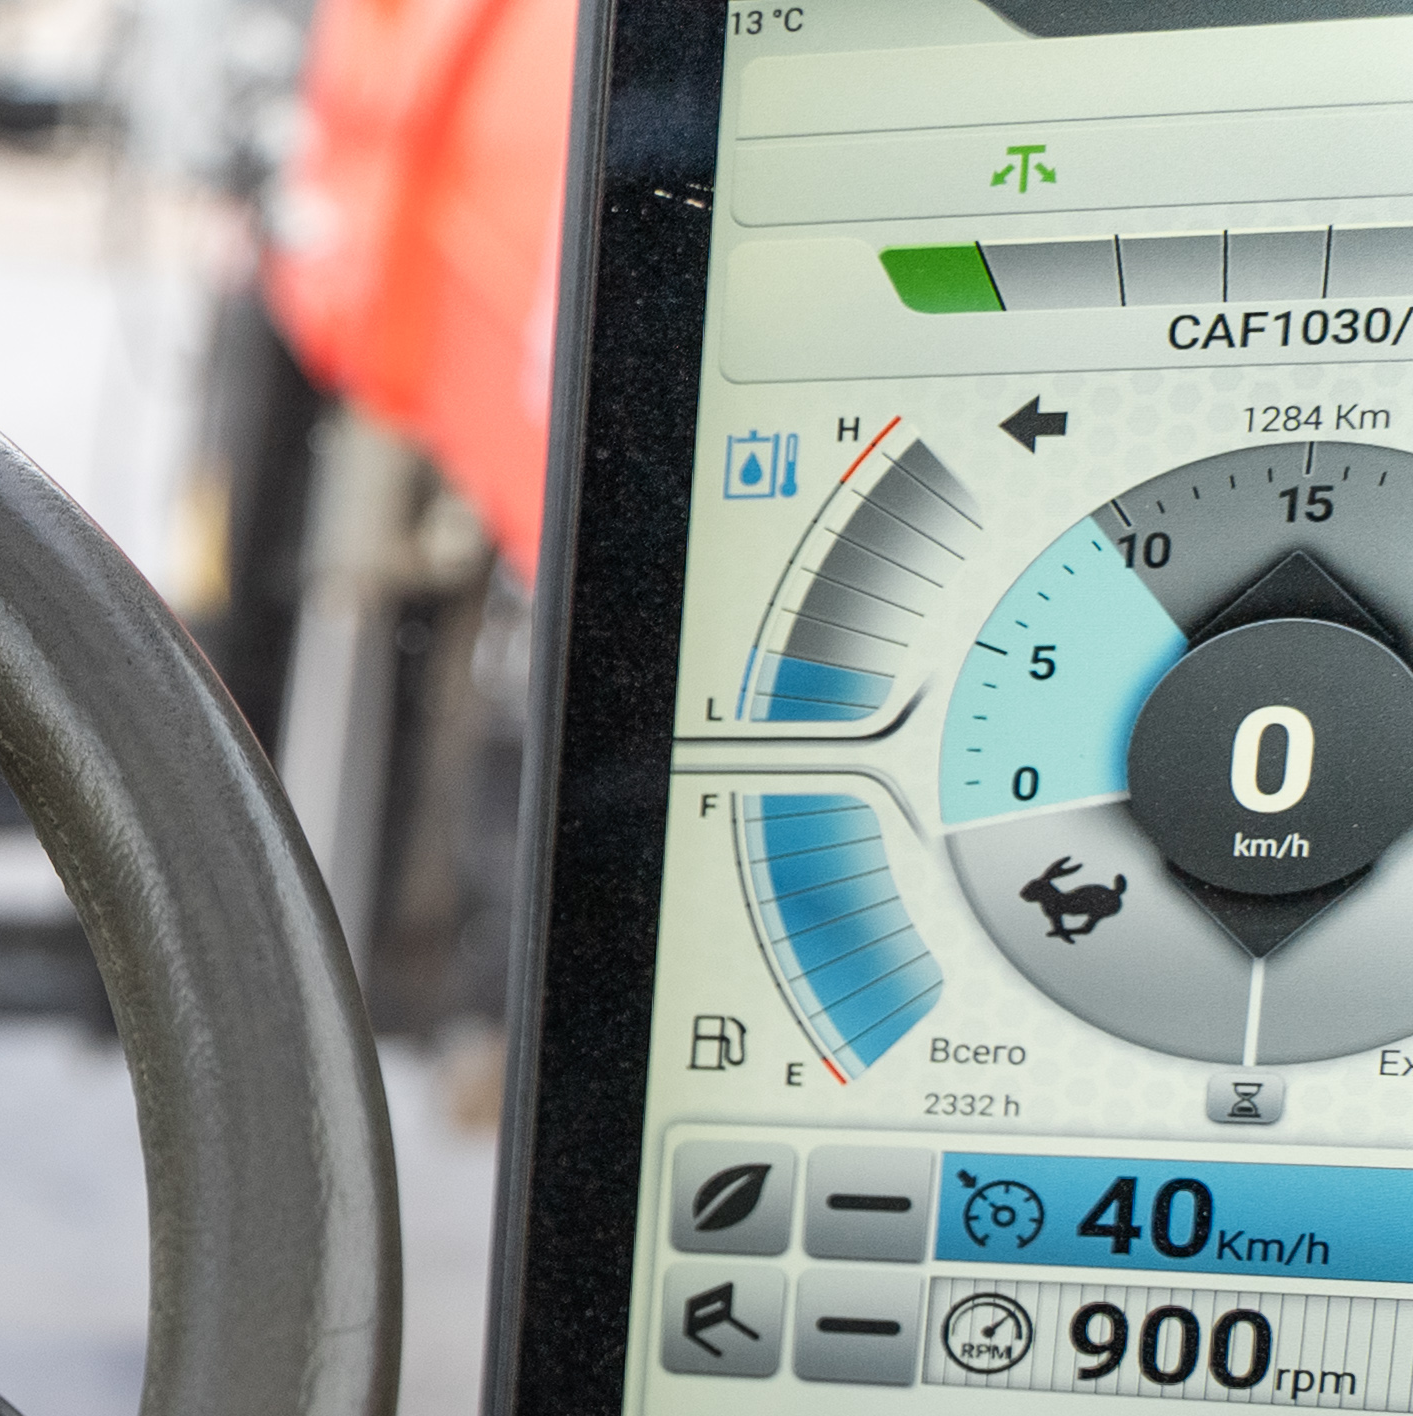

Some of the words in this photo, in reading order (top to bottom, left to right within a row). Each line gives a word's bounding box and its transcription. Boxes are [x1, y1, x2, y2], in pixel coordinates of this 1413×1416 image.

[732, 11, 763, 35] 13
[773, 7, 803, 32] °C
[838, 417, 861, 443] H
[1244, 405, 1322, 433] 1284
[1335, 404, 1390, 430] Km
[1279, 485, 1335, 524] 15
[1116, 531, 1171, 569] 10
[1029, 645, 1057, 681] 5
[705, 697, 723, 723] L
[1229, 705, 1315, 814] 0
[1011, 766, 1040, 802] 0
[699, 794, 717, 818] F
[1232, 833, 1310, 860] km/h
[786, 1063, 803, 1087] E
[923, 1092, 995, 1117] 2332
[1003, 1094, 1021, 1117] h
[1077, 1176, 1215, 1258] 40
[1216, 1230, 1331, 1267] Km/h
[960, 1342, 1013, 1360] RPM
[1069, 1300, 1274, 1390] 900
[1275, 1369, 1358, 1399] rpm
